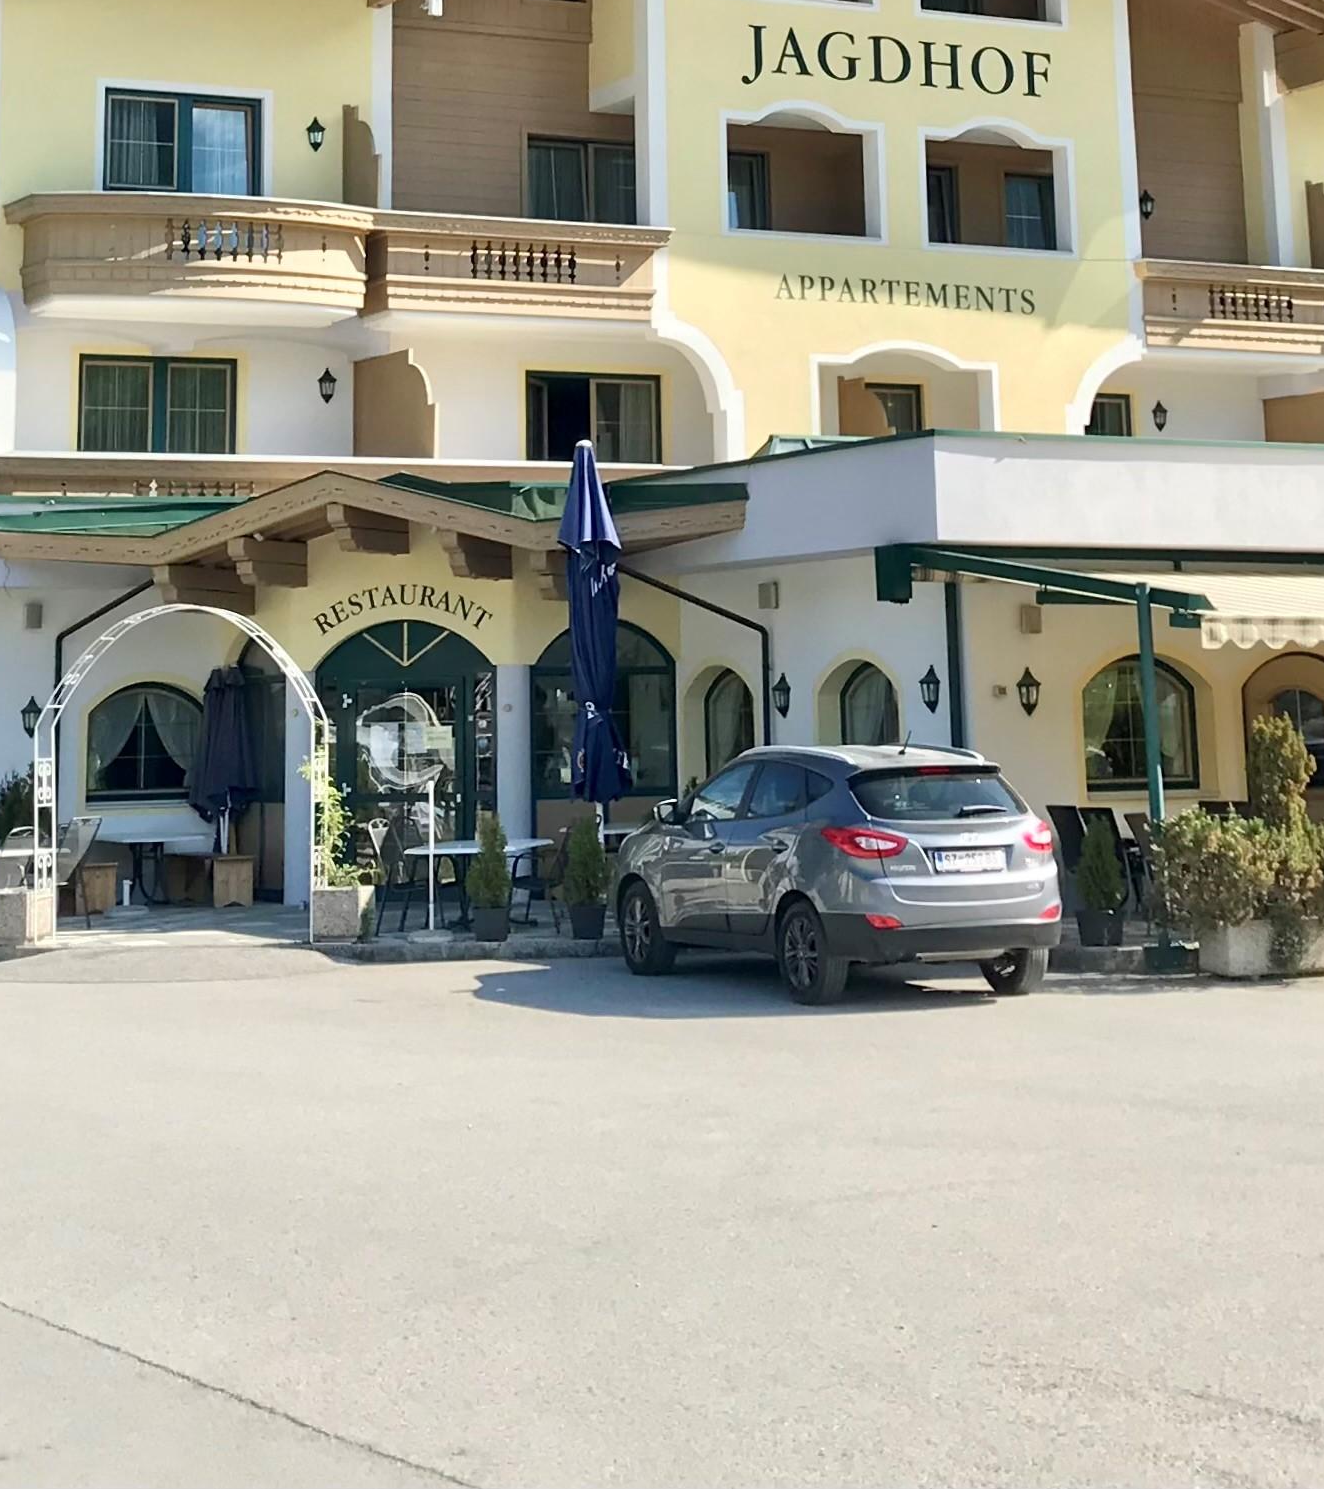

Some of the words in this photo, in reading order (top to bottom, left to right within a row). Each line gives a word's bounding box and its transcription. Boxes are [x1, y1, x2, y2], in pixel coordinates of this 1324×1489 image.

[741, 24, 1052, 98] JAGDHOF
[774, 272, 1037, 316] APPARTEMENTS
[312, 583, 494, 637] RESTAURANT
